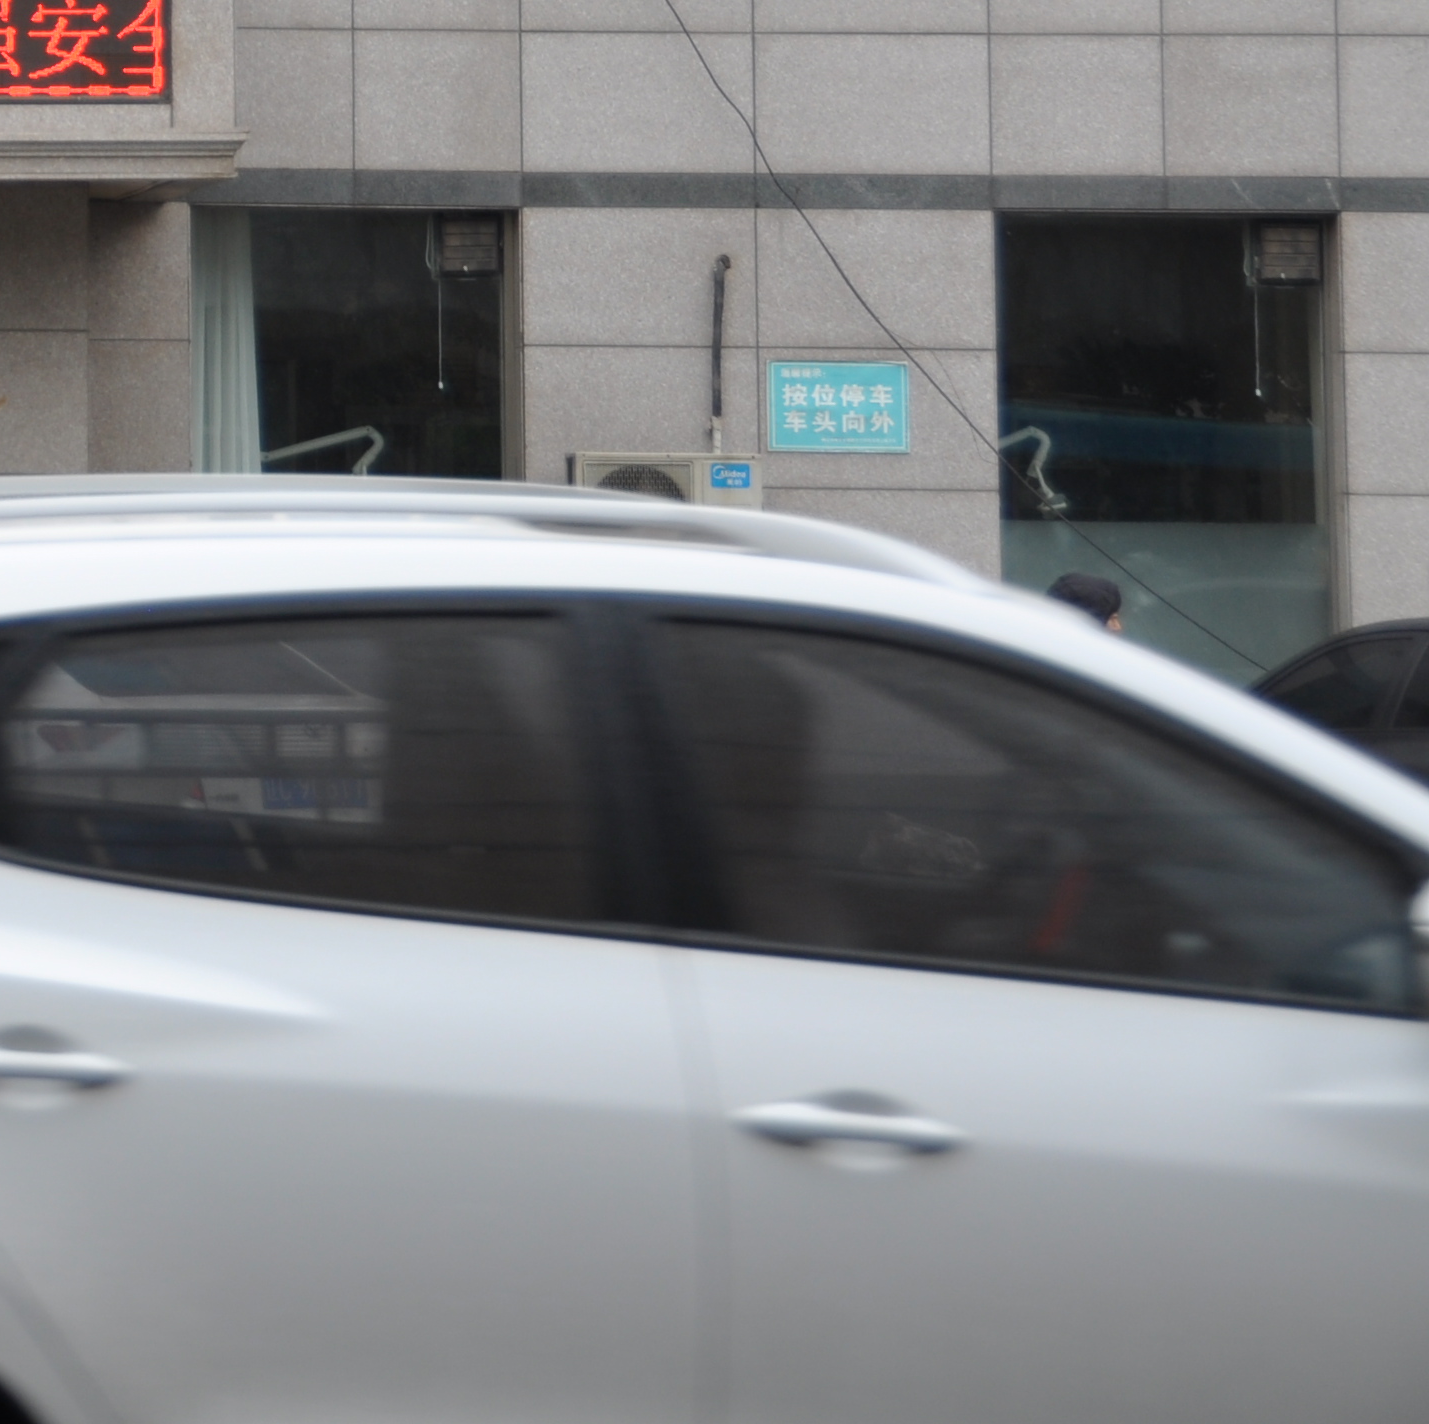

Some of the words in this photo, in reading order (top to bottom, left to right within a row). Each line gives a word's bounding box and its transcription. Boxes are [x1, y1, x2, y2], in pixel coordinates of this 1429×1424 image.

[782, 384, 893, 407] 按位停车
[783, 410, 895, 433] 车头向外
